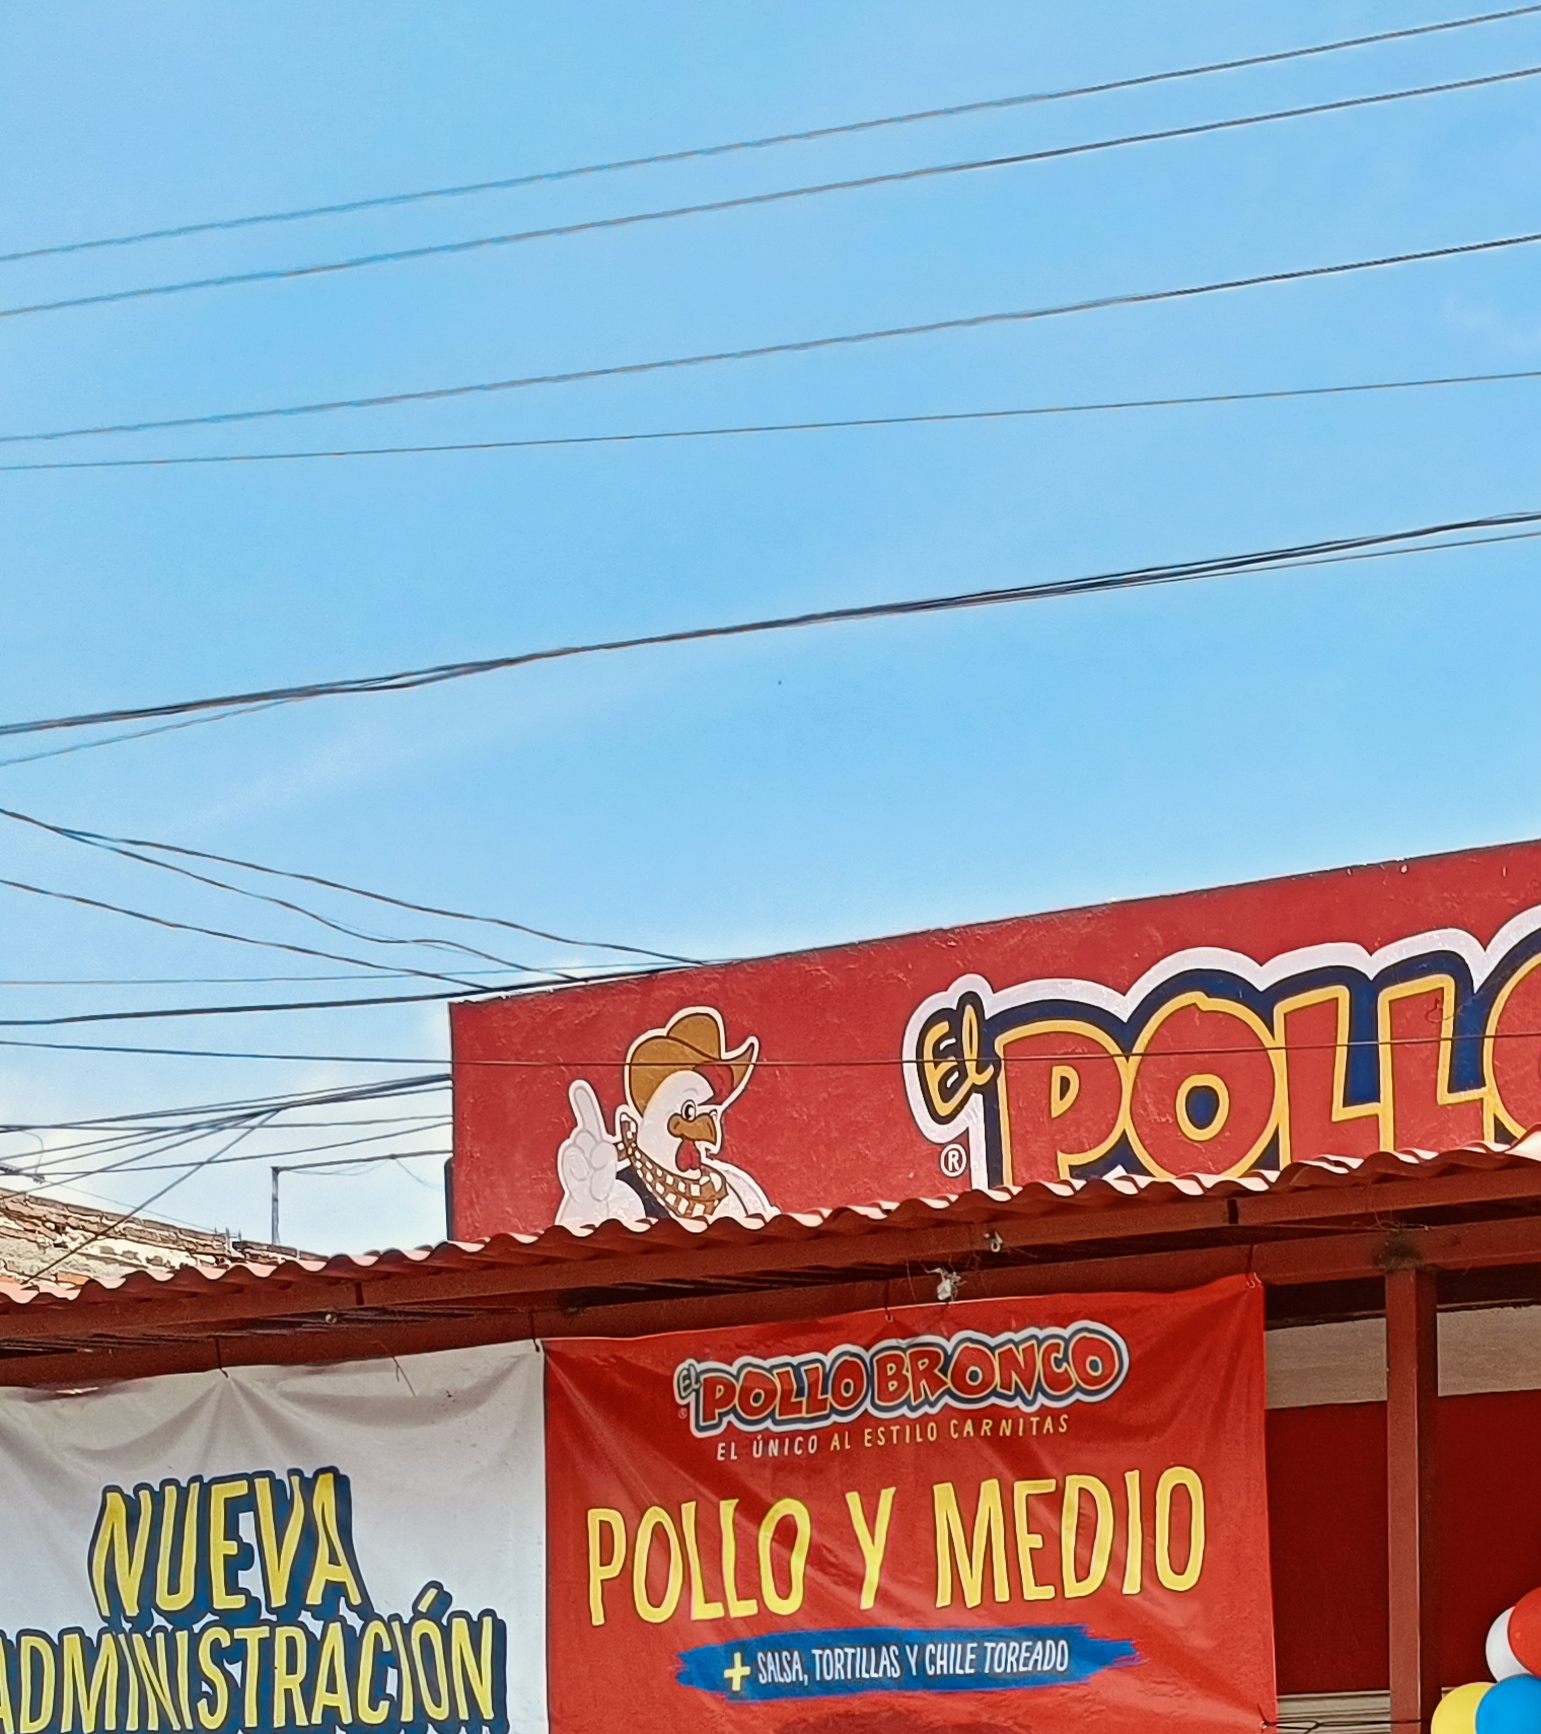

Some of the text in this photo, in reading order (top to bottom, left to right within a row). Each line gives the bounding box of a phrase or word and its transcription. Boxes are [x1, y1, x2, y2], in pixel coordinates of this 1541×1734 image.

[921, 1000, 997, 1119] El
[698, 1356, 857, 1426] POLLO
[873, 1327, 1120, 1405] BRONCO
[717, 1413, 1070, 1461] EL ÚNICO AL ESTILO CARNITAS
[94, 1471, 363, 1618] NUEVA
[586, 1466, 1206, 1627] POLLO Y MEDIO
[757, 1650, 808, 1686] SALSA,
[812, 1646, 901, 1682] TORTILLAS
[903, 1645, 922, 1676] Y
[925, 1643, 975, 1675] CHILE
[983, 1640, 1069, 1674] TOREADO
